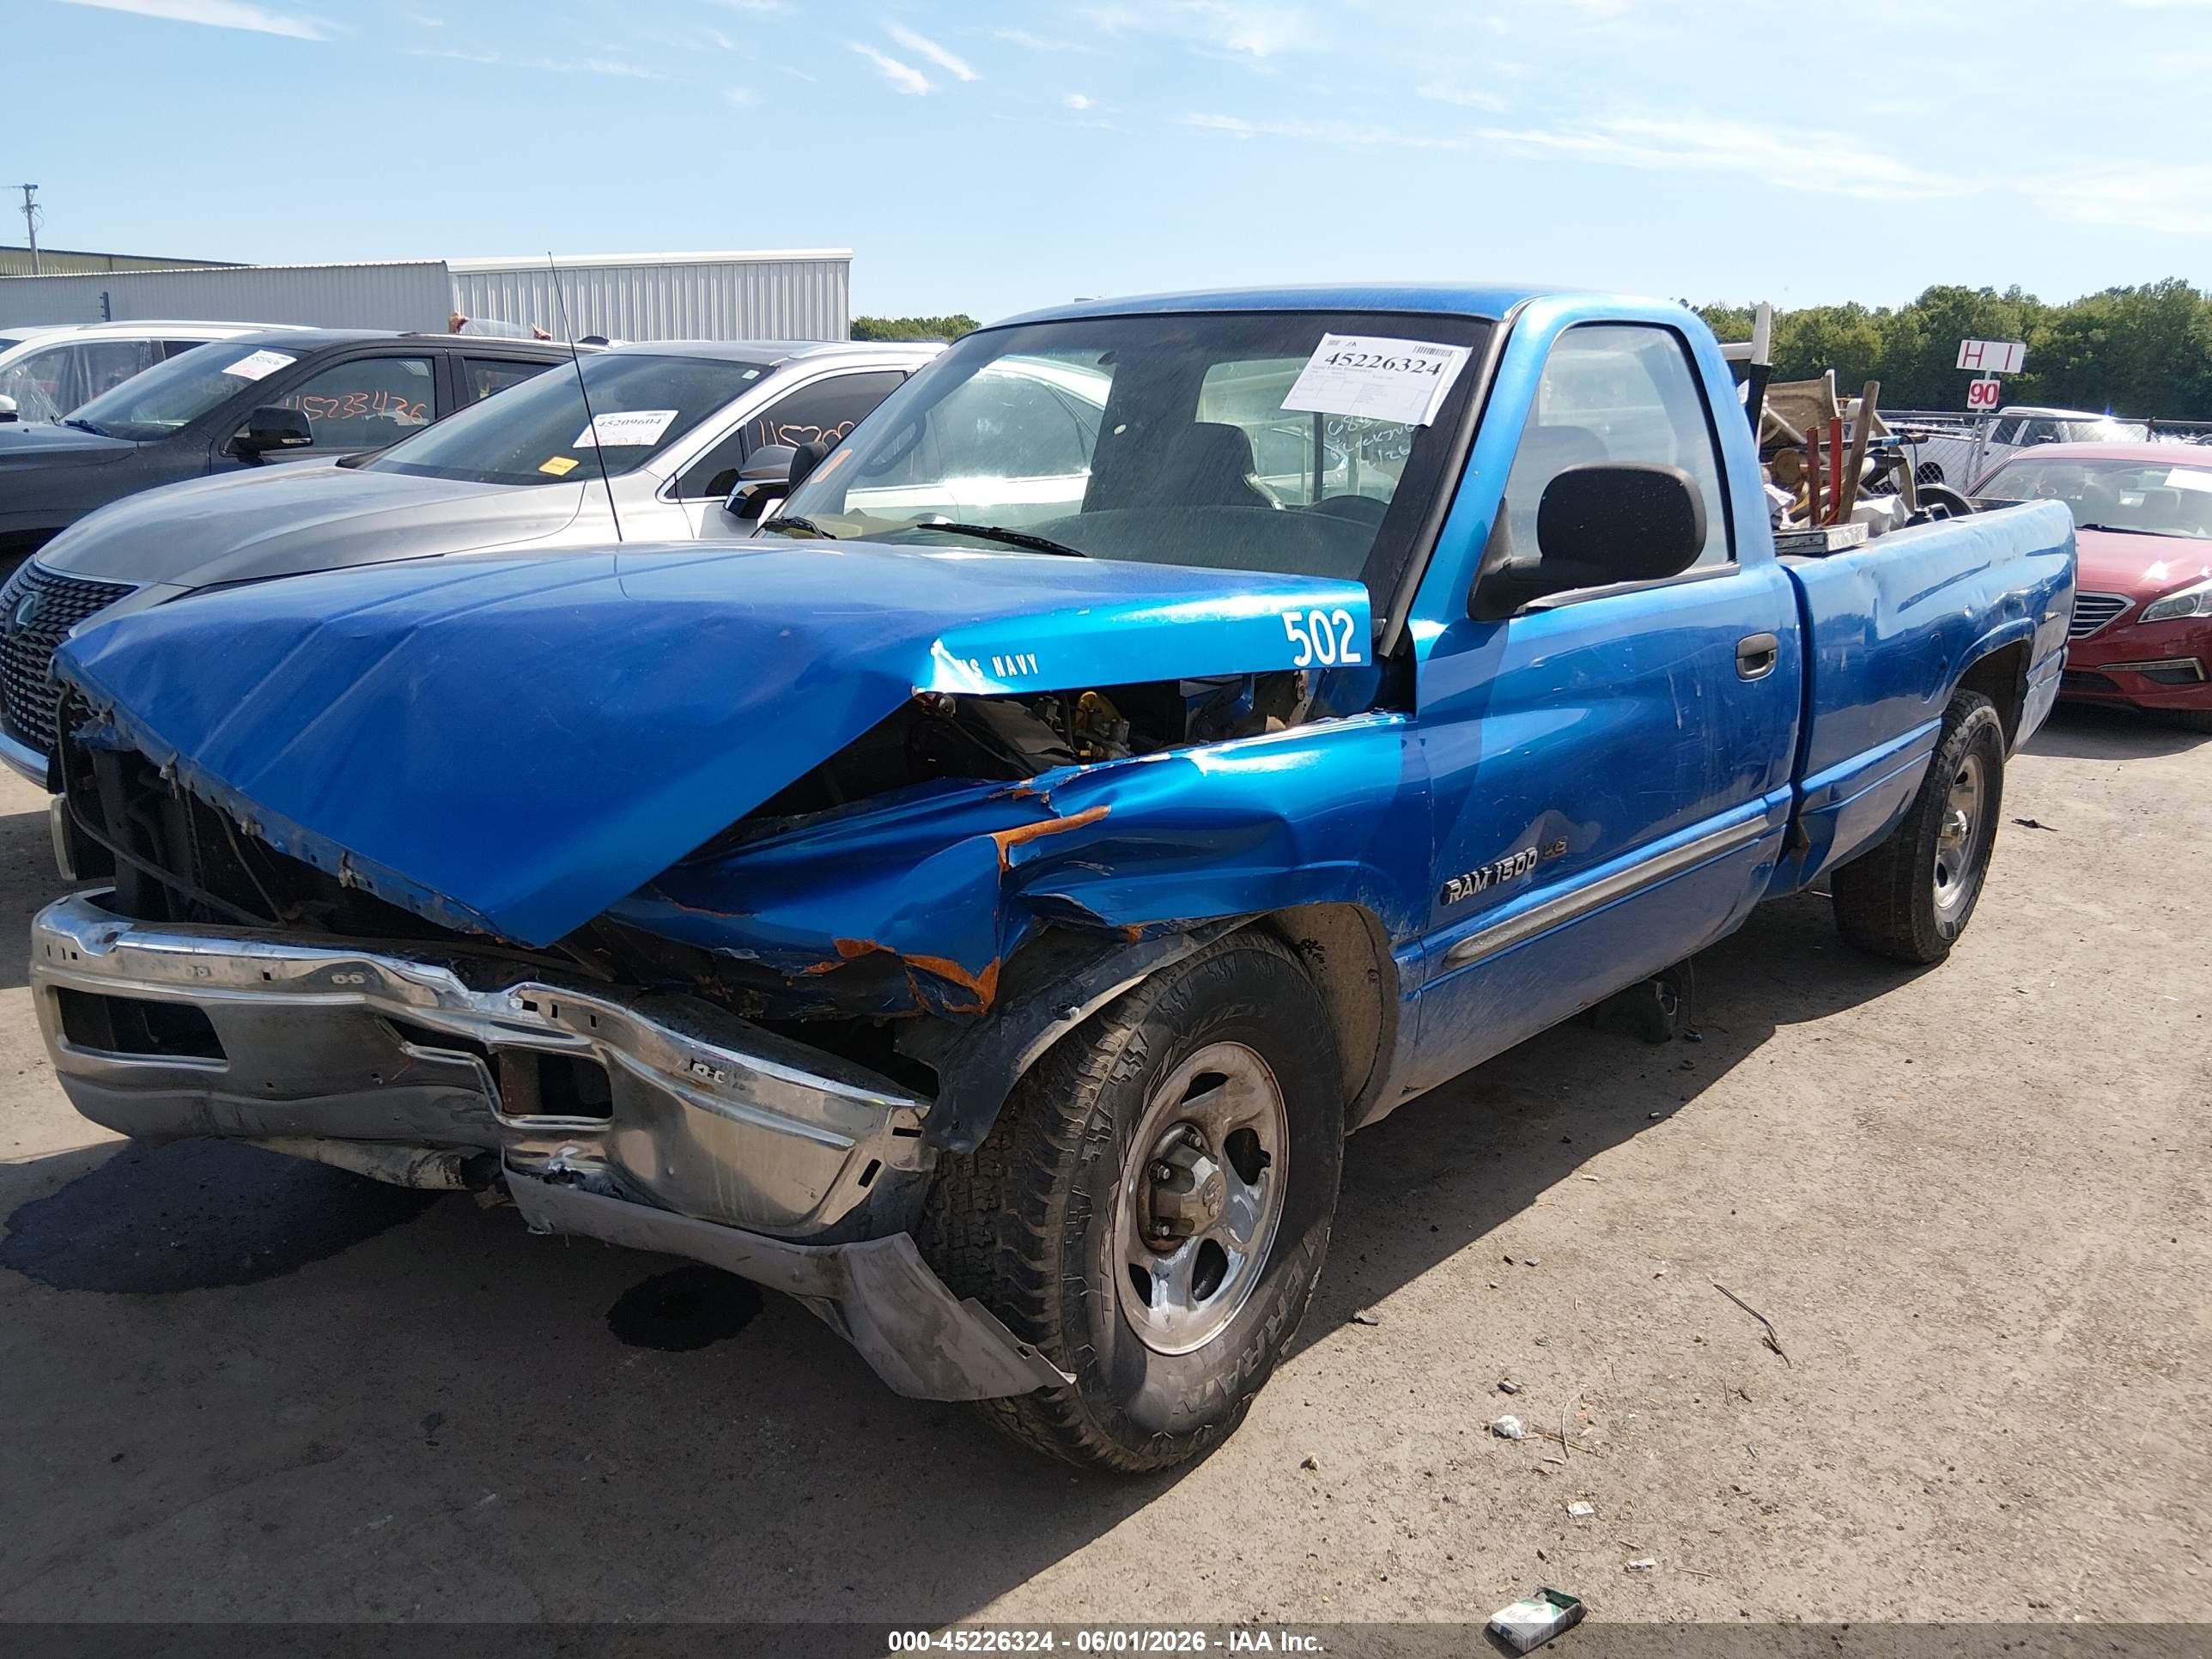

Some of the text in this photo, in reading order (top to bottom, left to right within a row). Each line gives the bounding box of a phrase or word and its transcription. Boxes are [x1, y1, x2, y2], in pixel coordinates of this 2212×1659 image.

[1324, 351, 1443, 376] 45226324
[1961, 342, 1984, 368] H
[1970, 383, 1998, 404] 90
[1281, 609, 1361, 667] 502
[992, 653, 1038, 678] NAVY
[1442, 867, 1492, 905] RAM
[1494, 847, 1539, 884] 1500
